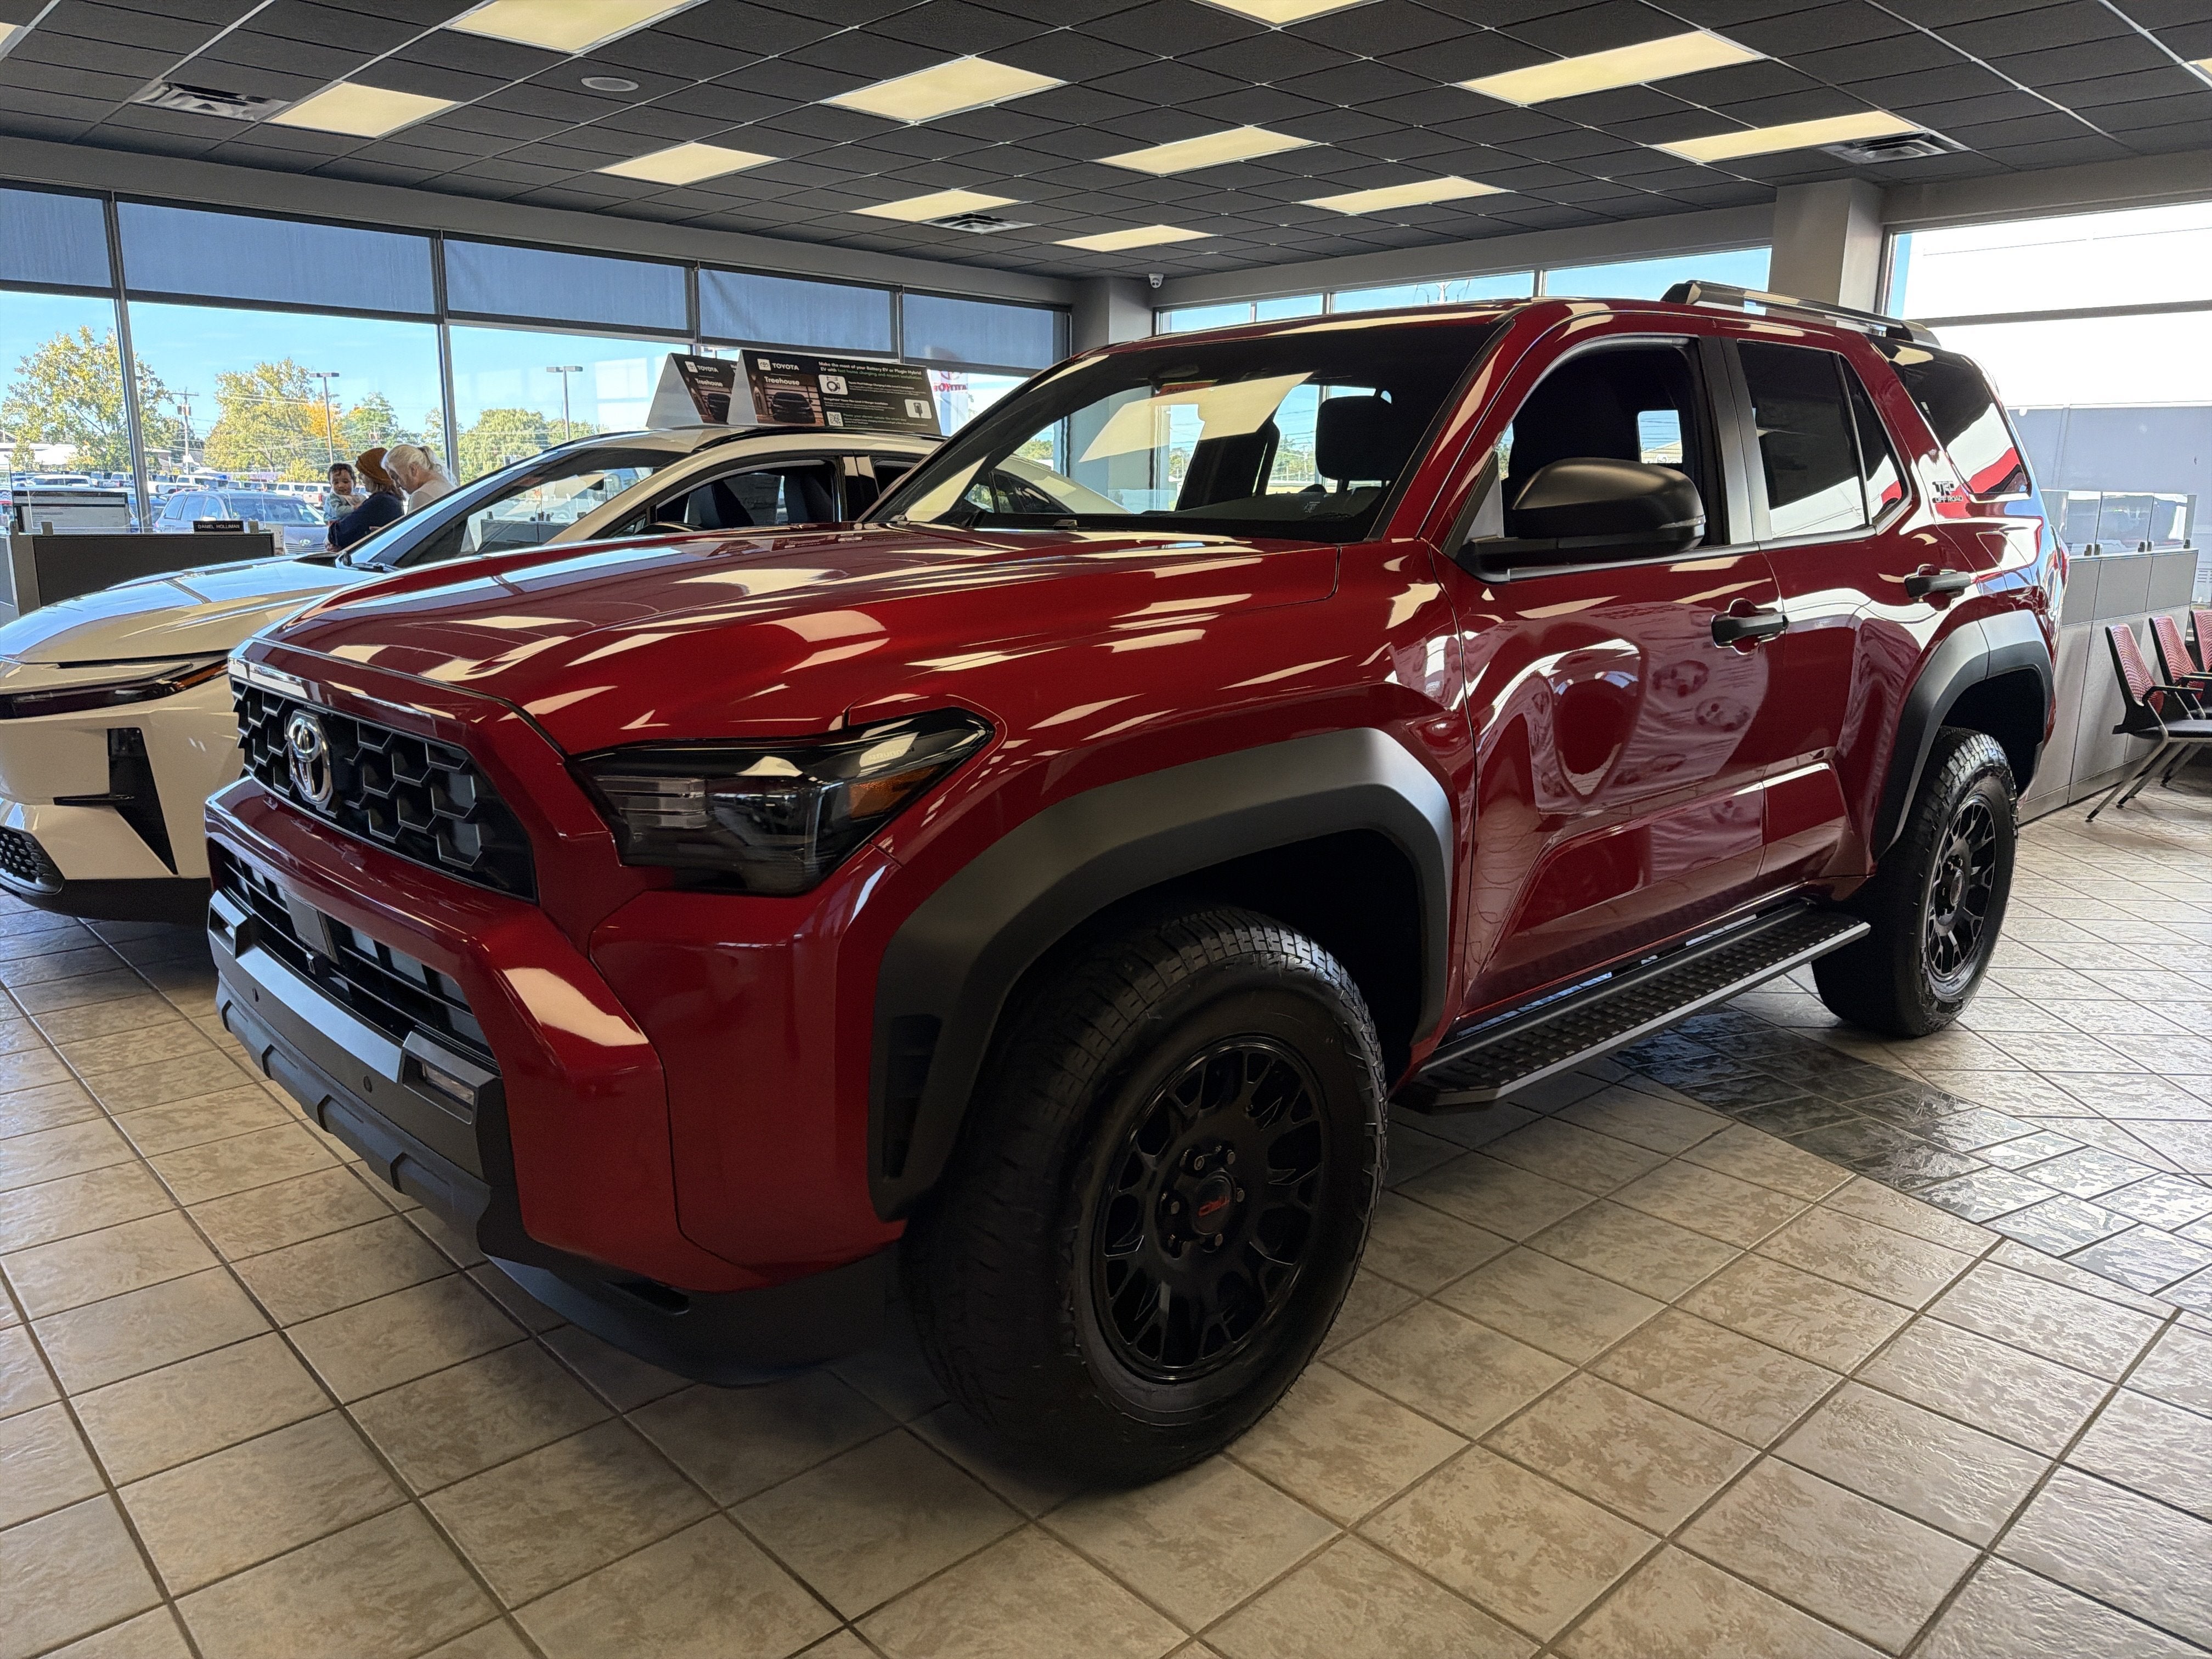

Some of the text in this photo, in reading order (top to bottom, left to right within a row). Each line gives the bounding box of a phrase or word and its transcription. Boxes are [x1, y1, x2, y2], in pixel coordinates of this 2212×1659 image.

[772, 363, 800, 371] TOYOTA
[695, 378, 724, 387] Treehouse
[764, 376, 800, 386] Treehouse
[1932, 481, 1956, 496] TRD
